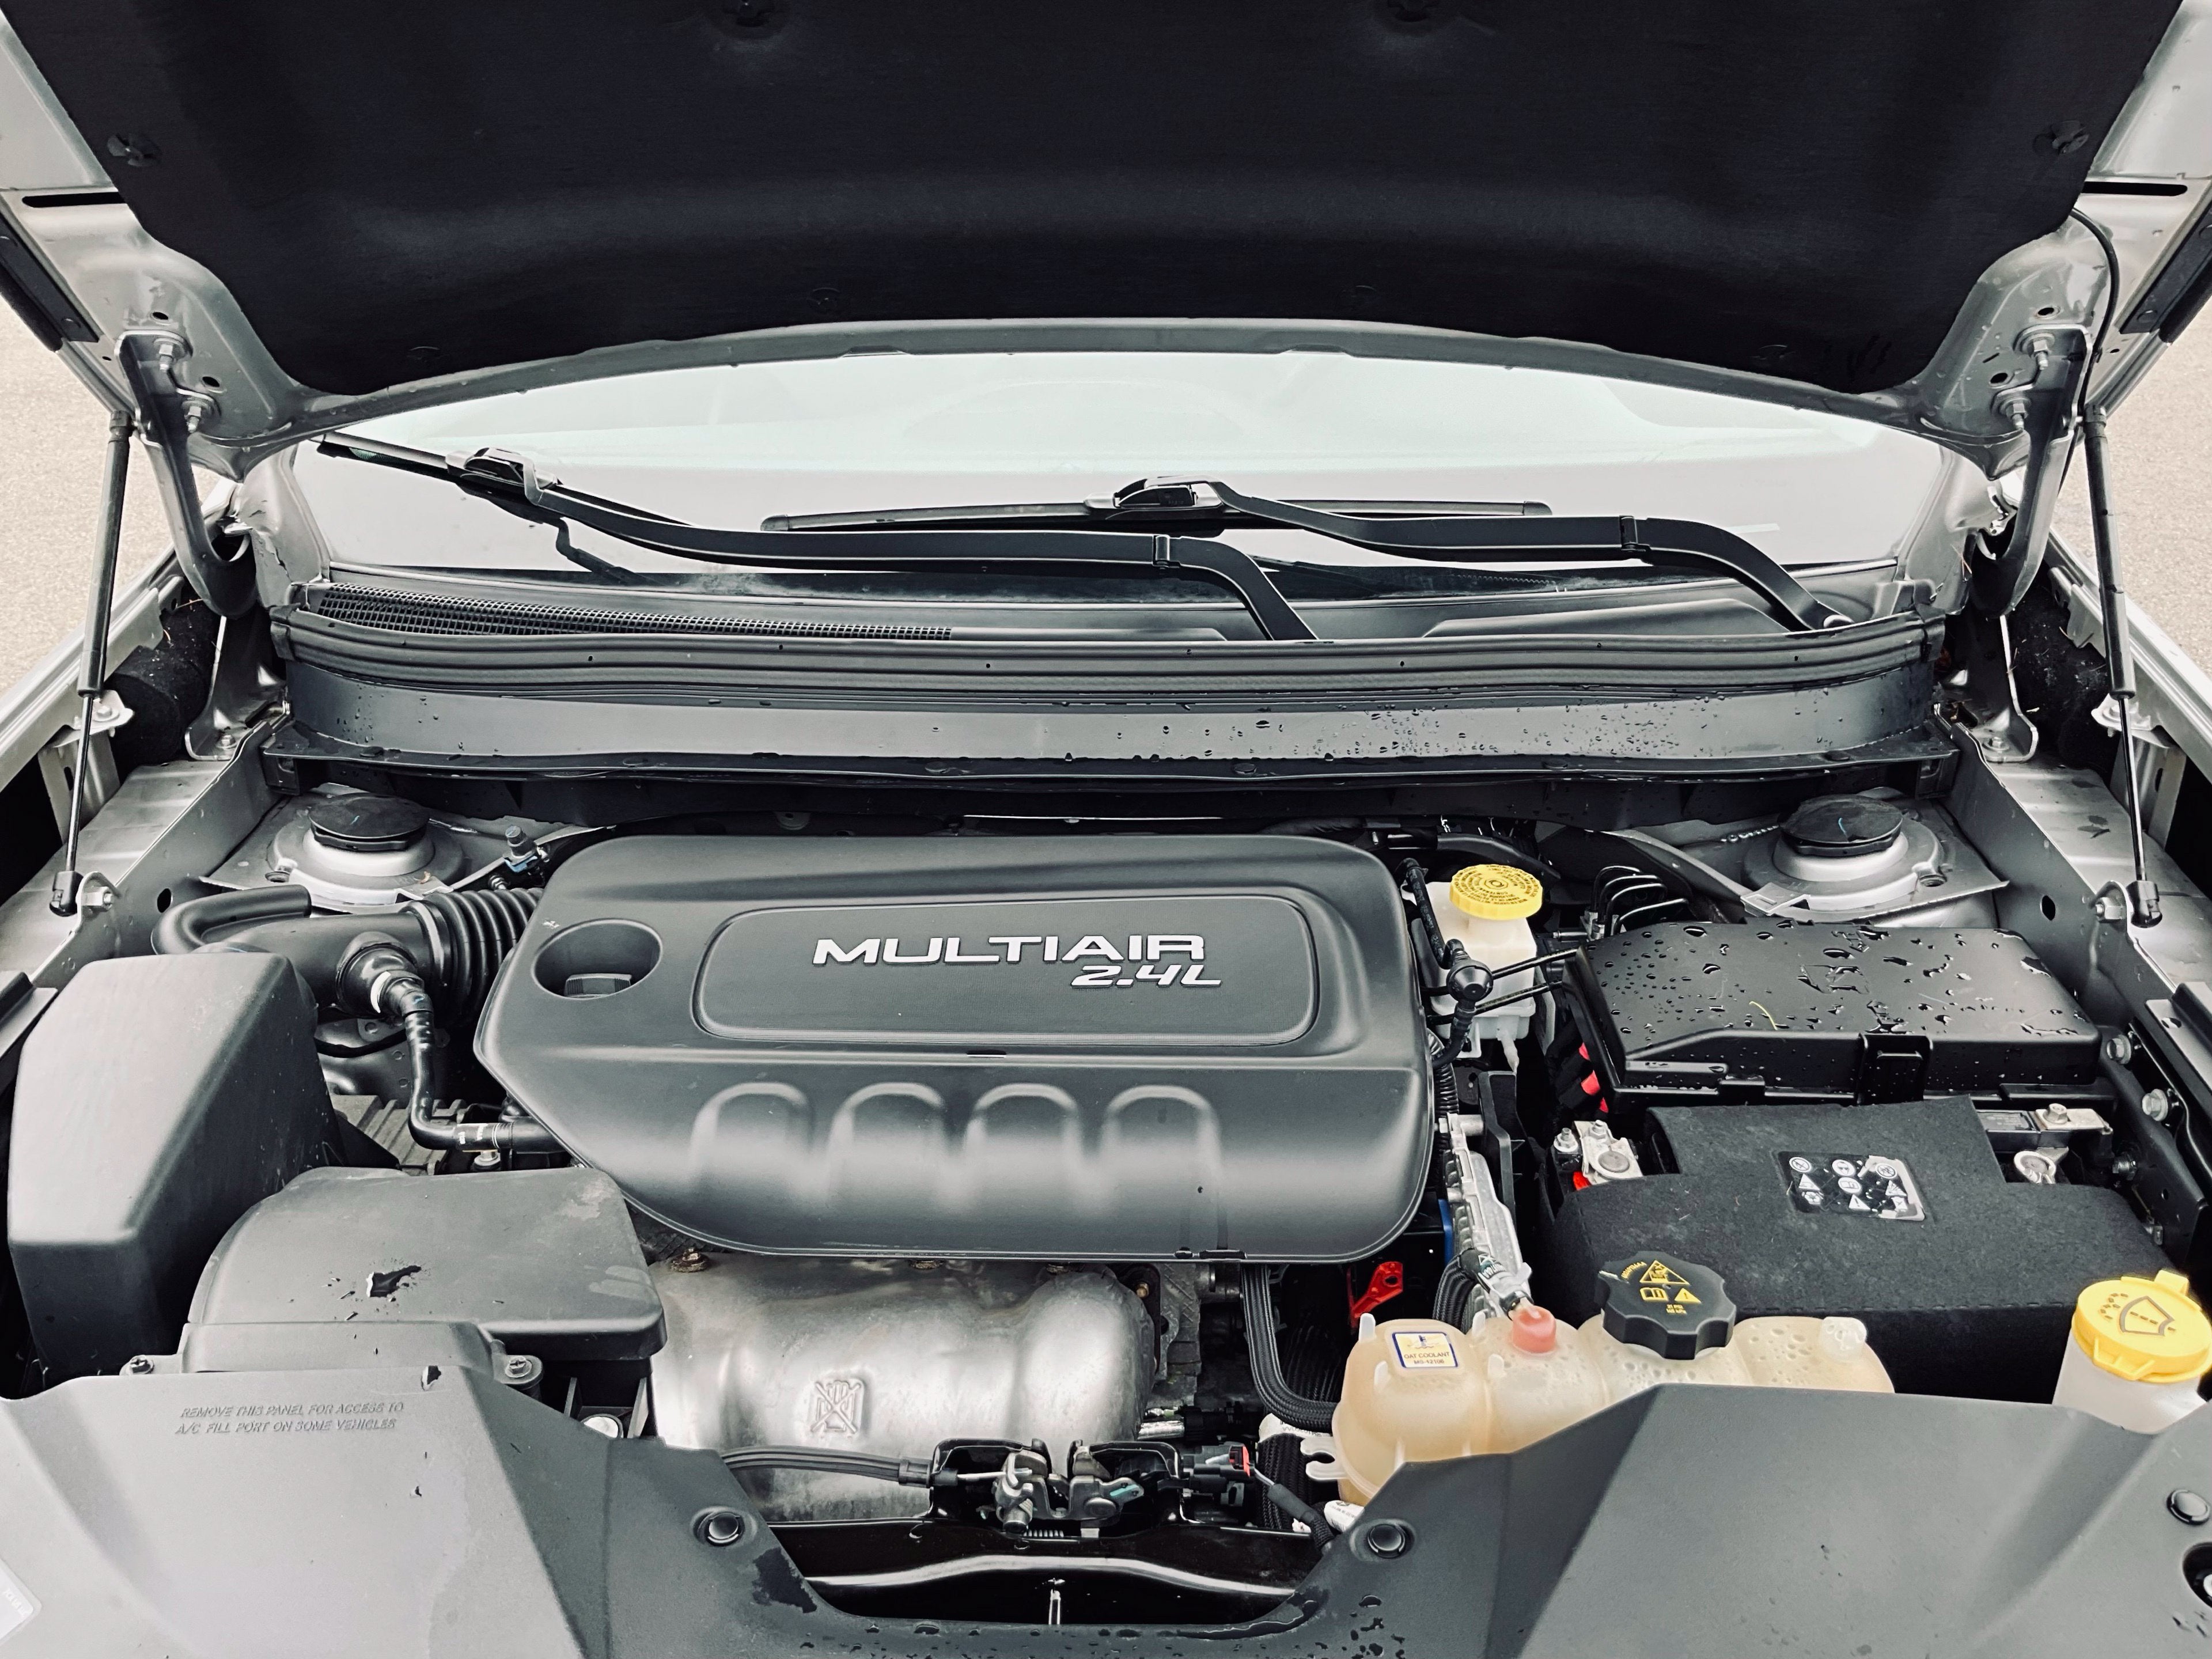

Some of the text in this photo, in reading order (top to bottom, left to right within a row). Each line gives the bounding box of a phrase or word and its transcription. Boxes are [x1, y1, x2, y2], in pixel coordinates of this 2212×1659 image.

[812, 934, 1206, 965] MULTIAIR
[1070, 964, 1222, 987] 2.4L
[180, 1401, 404, 1418] REMOVE THIS PANEL FOR ACCESS TO
[175, 1418, 397, 1434] A/C FILL PORT ON SOME VEHICLES
